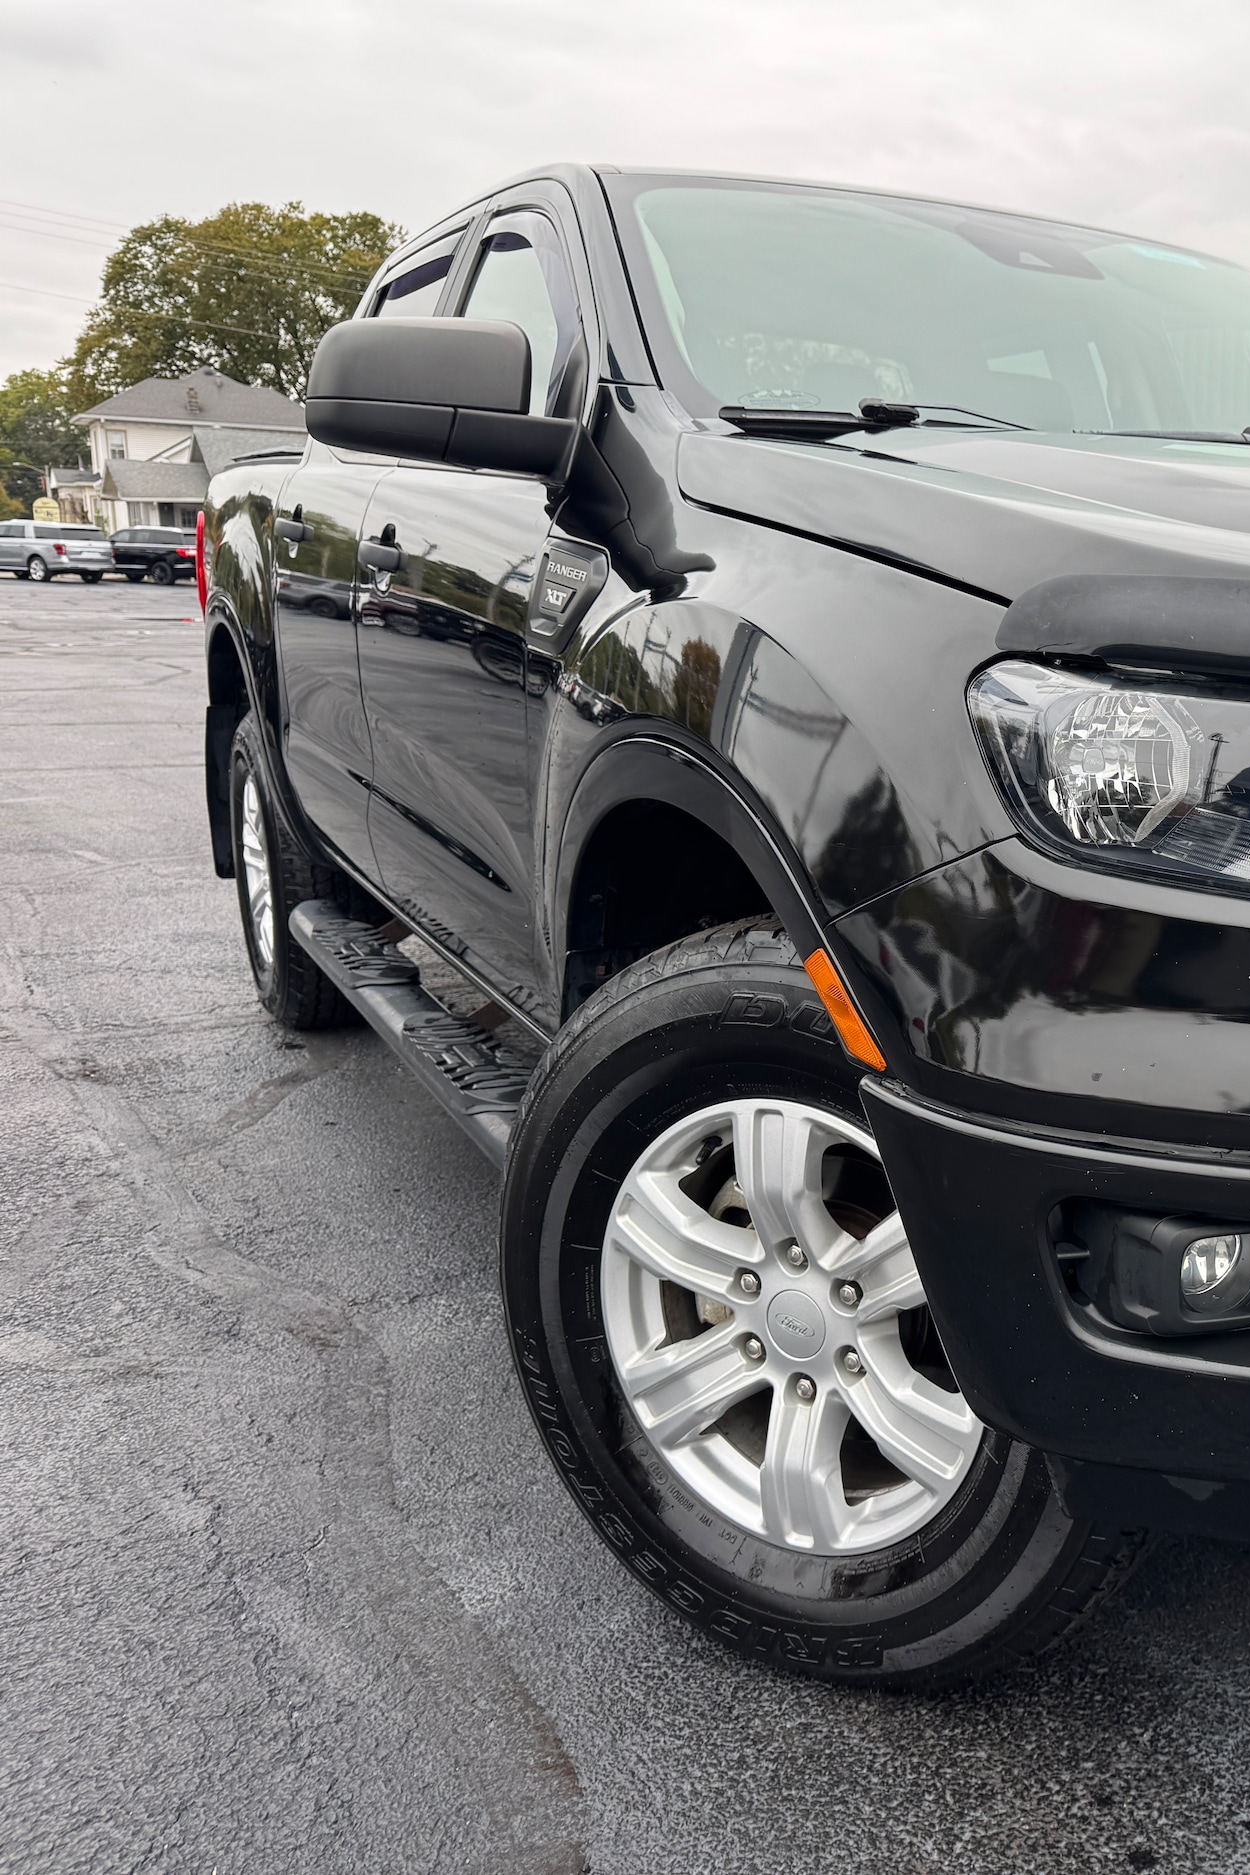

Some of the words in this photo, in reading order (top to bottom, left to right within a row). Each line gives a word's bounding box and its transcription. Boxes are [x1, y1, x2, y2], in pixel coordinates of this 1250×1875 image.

[547, 562, 587, 581] RANGER
[545, 589, 567, 605] XLT
[781, 1315, 808, 1336] Ford
